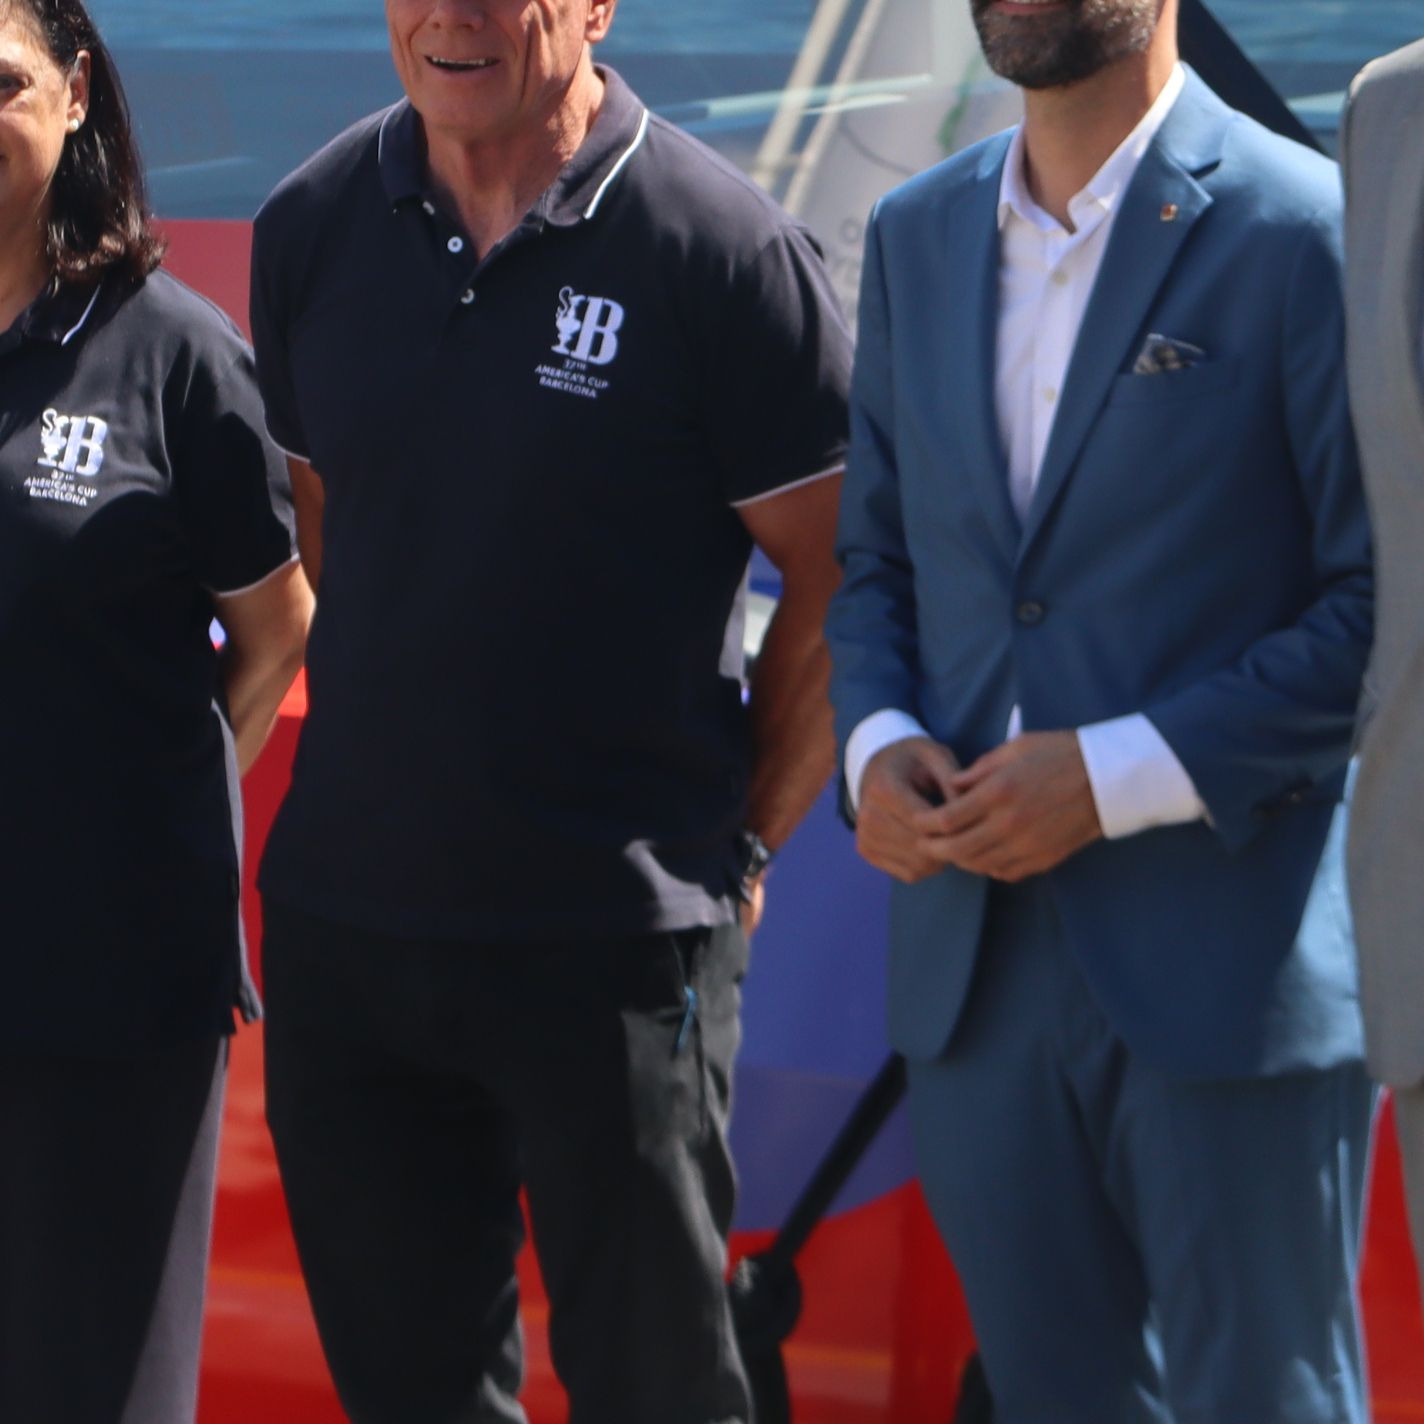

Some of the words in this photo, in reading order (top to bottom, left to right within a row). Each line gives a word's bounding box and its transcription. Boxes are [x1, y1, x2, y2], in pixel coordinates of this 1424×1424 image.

[538, 375, 598, 399] BARCELONA
[587, 376, 610, 390] CUP
[29, 485, 88, 508] BARCELONA
[77, 484, 99, 499] CUP
